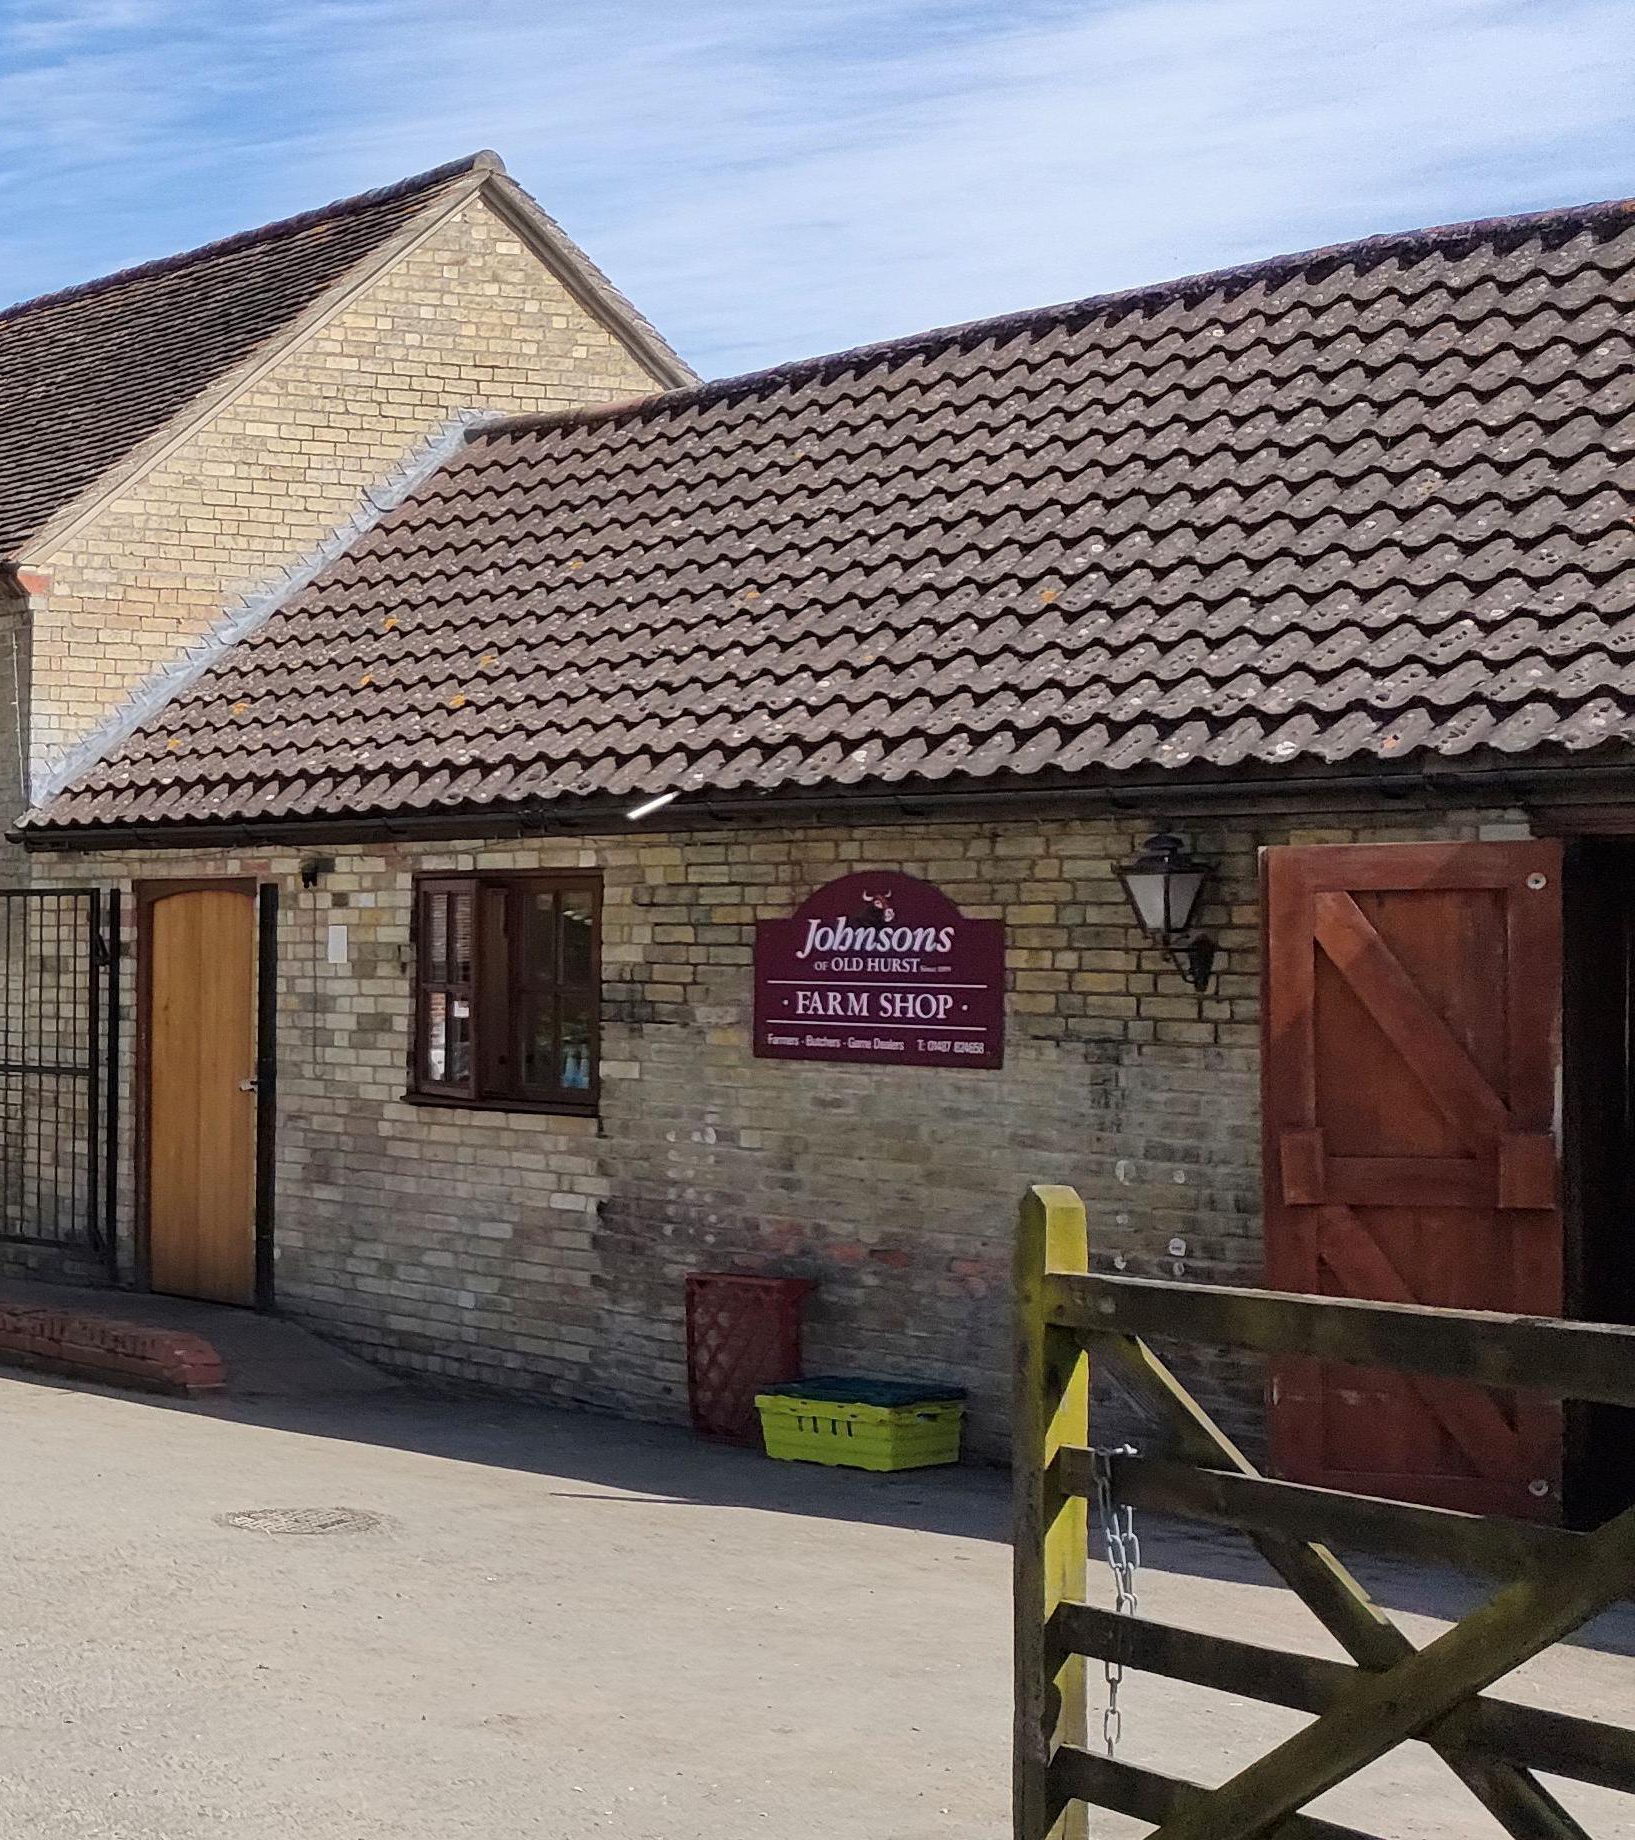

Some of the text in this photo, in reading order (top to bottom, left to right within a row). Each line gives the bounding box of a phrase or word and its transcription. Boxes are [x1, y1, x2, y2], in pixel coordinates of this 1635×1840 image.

[795, 916, 955, 959] Johnsons
[814, 960, 829, 971] OF
[831, 957, 864, 972] OLD
[867, 957, 921, 973] HURST
[795, 991, 954, 1020] FARM SHOP
